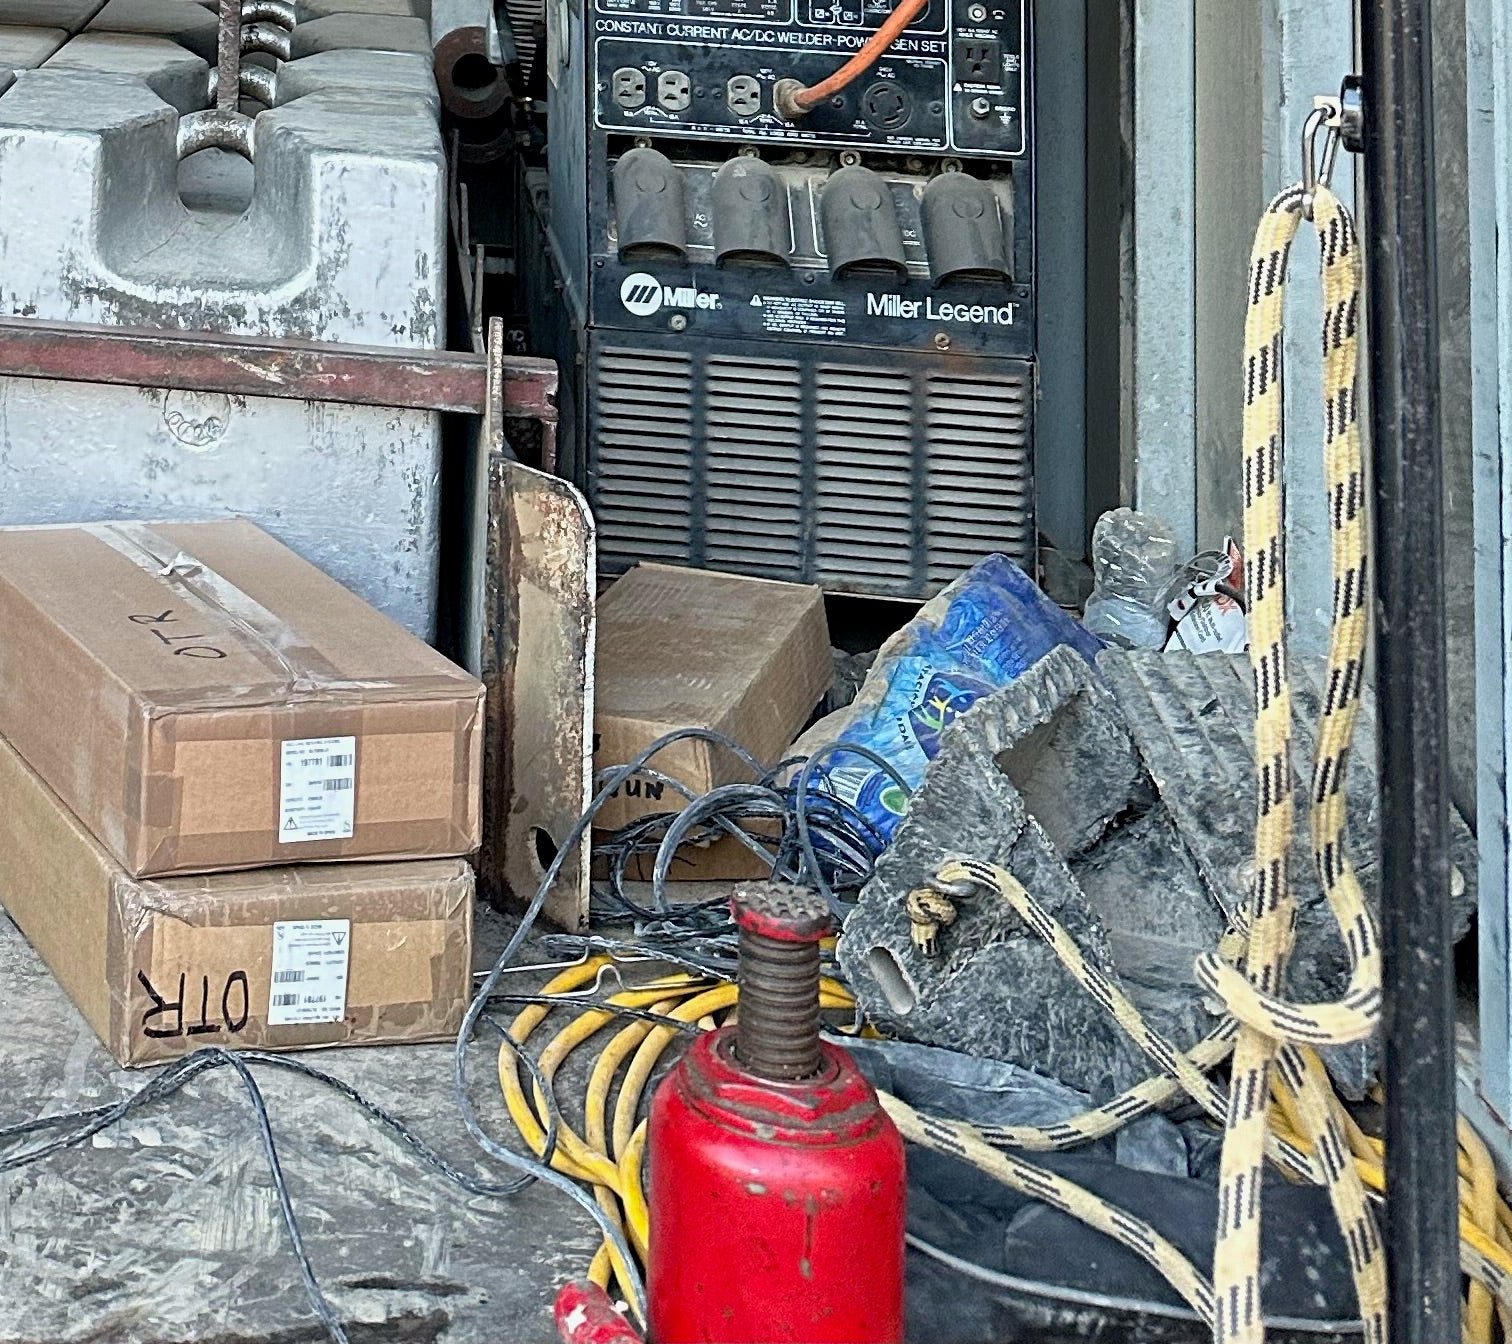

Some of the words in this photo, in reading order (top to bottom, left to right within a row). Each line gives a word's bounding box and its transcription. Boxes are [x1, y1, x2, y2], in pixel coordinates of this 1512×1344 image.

[595, 19, 663, 36] CONSTANT
[667, 23, 730, 40] CURRENT
[731, 28, 775, 43] AC/DC
[777, 31, 873, 48] WELDER-POW
[921, 40, 947, 53] SET
[867, 292, 922, 318] Miller
[128, 610, 227, 658] OTR
[137, 969, 249, 1039] OTR
